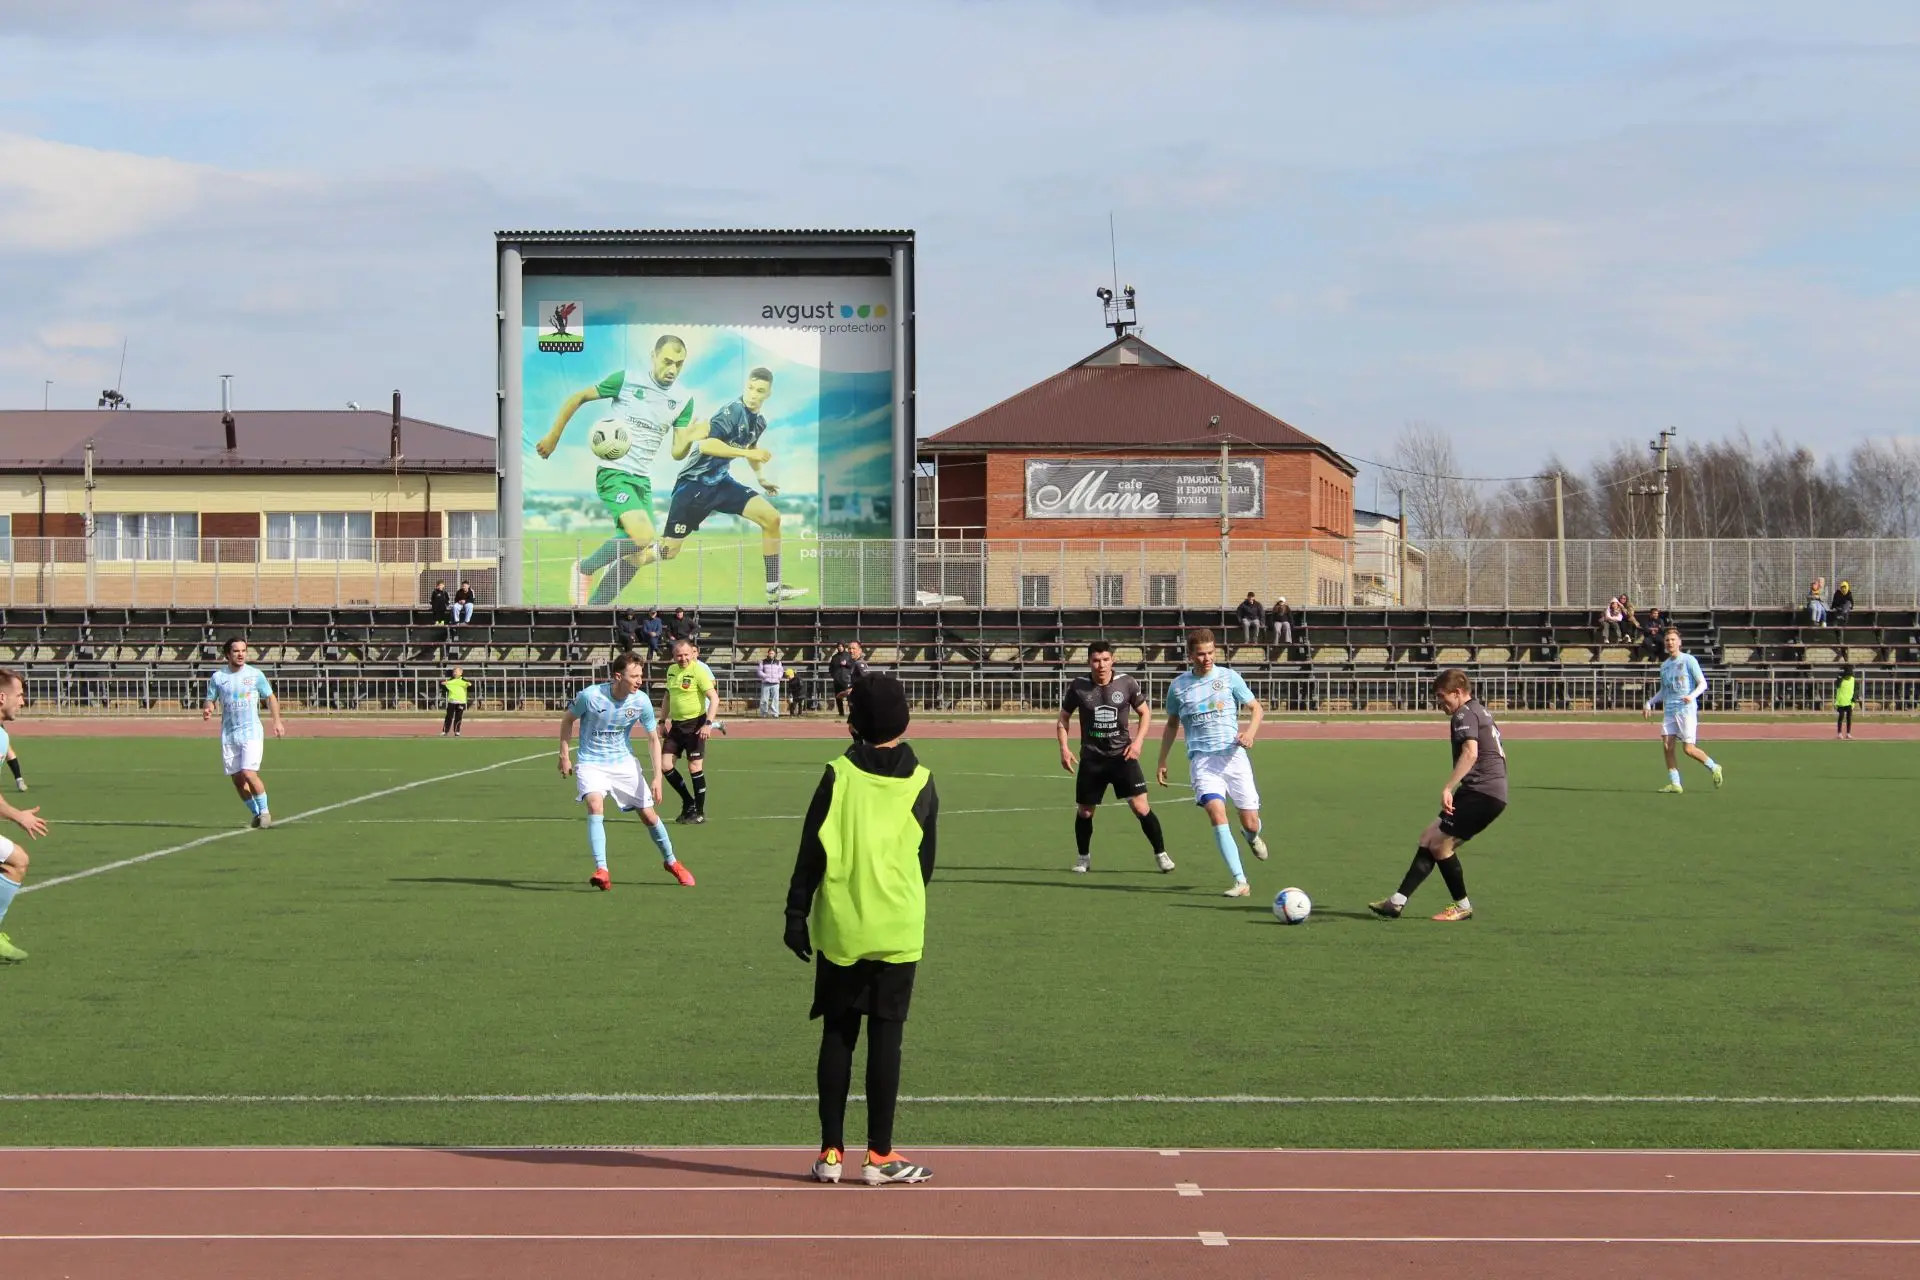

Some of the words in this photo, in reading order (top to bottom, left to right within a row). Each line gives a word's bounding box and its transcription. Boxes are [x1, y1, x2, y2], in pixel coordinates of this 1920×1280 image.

[761, 301, 834, 324] avgust
[801, 325, 827, 335] crop
[829, 322, 886, 335] protection
[1117, 478, 1143, 490] cafe
[1176, 475, 1233, 484] АРМЯНСКЯ
[1036, 469, 1160, 511] Mane
[1176, 486, 1184, 494] И
[1186, 485, 1250, 495] ЕВРОПЕСКАЯ
[1176, 496, 1208, 504] КУХНЯ
[674, 523, 687, 534] 69
[800, 528, 812, 541] С
